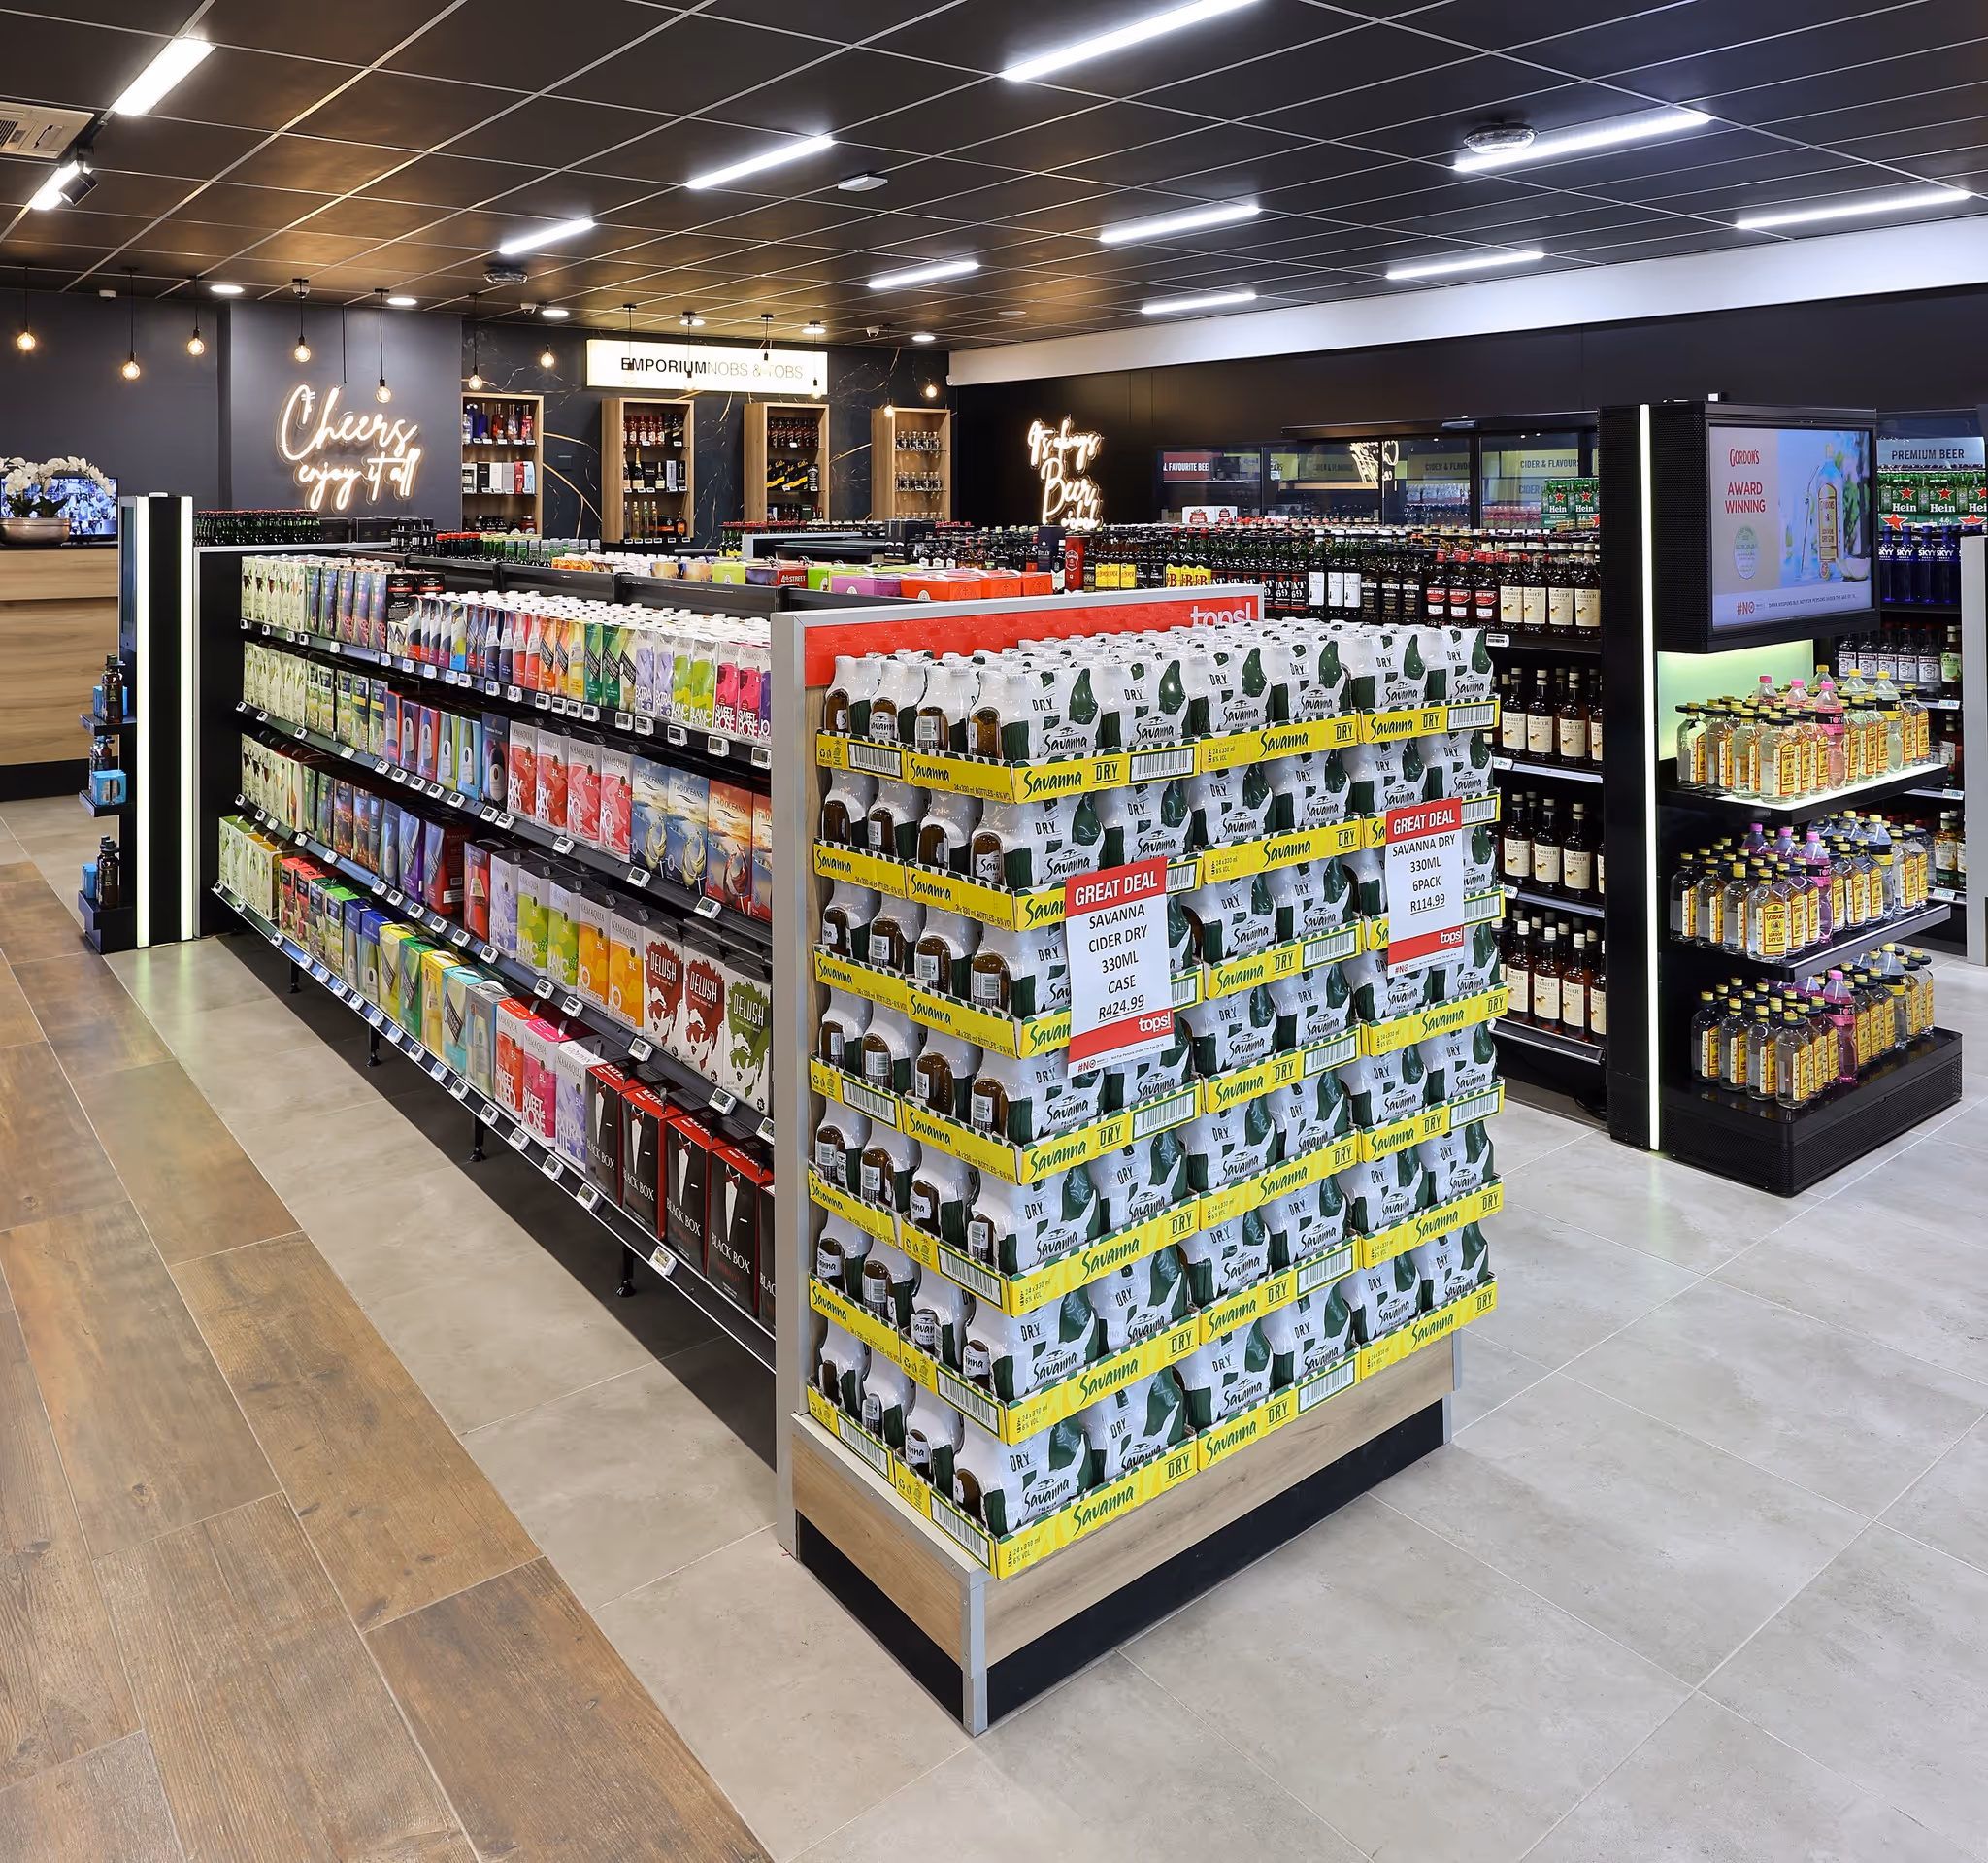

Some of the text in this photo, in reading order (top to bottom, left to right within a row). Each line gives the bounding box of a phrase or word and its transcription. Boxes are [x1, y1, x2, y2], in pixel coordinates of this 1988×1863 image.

[282, 384, 418, 460] Cheers
[1053, 418, 1101, 470] always
[1729, 448, 1760, 467] GORDON'S
[1891, 449, 1965, 460] PREMIUM BEER
[1169, 463, 1196, 472] FAVOURITE
[1520, 460, 1540, 469] CIDER
[299, 448, 420, 510] enjoy it all
[1041, 457, 1097, 524] Beer
[1727, 482, 1763, 496] AWARD
[1575, 504, 1593, 513] Hein
[1725, 498, 1766, 514] WINNING
[1892, 503, 1917, 512] Hein
[1930, 504, 1956, 513] Hein
[1209, 673, 1227, 685] DRY
[1032, 699, 1053, 711] DRY
[1223, 707, 1259, 726] Savanna
[1260, 732, 1309, 757] Savanna
[1336, 724, 1353, 740] DRY
[1371, 714, 1440, 740] Savanna DRY
[1044, 735, 1088, 755] Savanna
[646, 773, 665, 786] OCEANS
[911, 758, 950, 782] Savanna
[1023, 771, 1082, 799] Savanna
[1096, 763, 1118, 781] DRY
[683, 785, 704, 799] OCEANS
[724, 800, 746, 814] OCEANS
[1394, 809, 1455, 835] GREAT DEAL
[1263, 831, 1354, 867] Savanna DRY
[1393, 834, 1455, 857] SAVANNA DRY
[817, 849, 852, 873] Savanna
[1409, 856, 1441, 873] 330ML
[911, 873, 952, 901] Savanna
[1075, 870, 1158, 907] GREAT DEAL
[1412, 876, 1441, 892] 6PACK
[1089, 903, 1145, 930] SAVANNA
[1410, 893, 1445, 913] R114.99
[612, 920, 638, 942] NAMAQUA
[1088, 925, 1148, 953] CIDER DRY
[1440, 927, 1463, 944] tops!
[650, 950, 678, 982] DELUSH
[818, 958, 853, 984] Savanna
[1101, 950, 1139, 974] 330ML
[1215, 953, 1294, 996] Savanna DRY
[689, 970, 718, 1003] DELUSH
[1108, 975, 1136, 994] CASE
[733, 992, 764, 1027] DELUSH
[911, 994, 952, 1025] Savanna
[1099, 994, 1144, 1020] R424.99
[1422, 996, 1504, 1038] Savanna DRY
[1138, 1011, 1172, 1033] tops!
[557, 1055, 582, 1079] NAMAQUA
[1215, 1062, 1294, 1109] Savanna DRY
[910, 1113, 951, 1146] Savanna
[1372, 1115, 1441, 1158] Savanna DRY
[586, 1137, 615, 1171] BLACK BOX
[1029, 1141, 1087, 1181] Savanna
[1100, 1124, 1121, 1147] DRY
[623, 1166, 654, 1202] BLACK BOX
[1259, 1147, 1352, 1203] Savanna DRY
[811, 1178, 844, 1212] Savanna
[666, 1196, 701, 1237] BLACK BOX
[1415, 1193, 1499, 1244] Savanna DRY
[711, 1231, 732, 1257] BLACK
[732, 1250, 751, 1275] BOX
[1081, 1213, 1193, 1281] Savanna DRY
[812, 1286, 847, 1322] Savanna
[1208, 1281, 1287, 1339] Savanna DRY
[1411, 1292, 1492, 1349] Savanna DRY
[1079, 1331, 1192, 1405] Savanna DRY
[1206, 1401, 1288, 1465] Savanna DRY
[1011, 1452, 1030, 1472] DRY
[1024, 1478, 1070, 1515] Savanna
[1073, 1456, 1189, 1537] Savanna DRY
